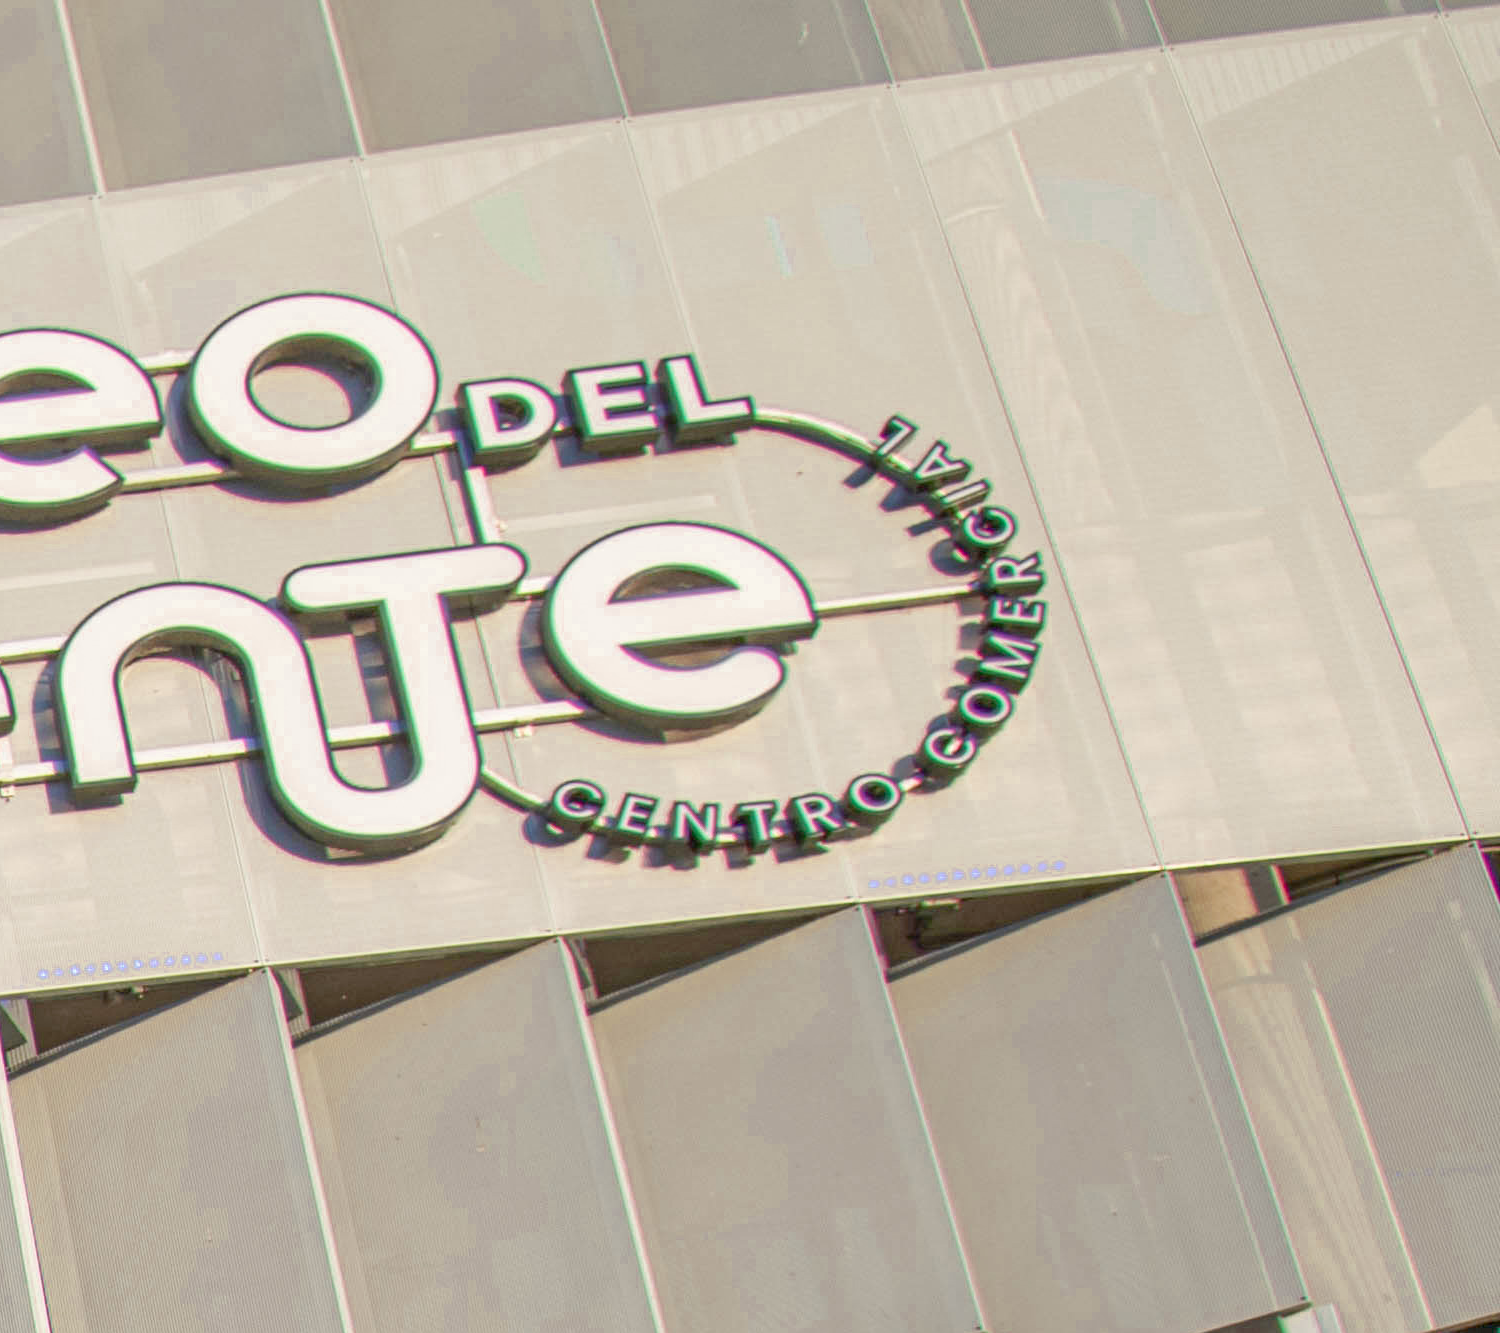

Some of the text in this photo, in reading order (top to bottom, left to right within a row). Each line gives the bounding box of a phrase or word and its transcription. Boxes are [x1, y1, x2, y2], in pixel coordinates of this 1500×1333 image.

[457, 354, 756, 466] DEL
[550, 414, 1048, 856] CENTRO COMERCIAL
